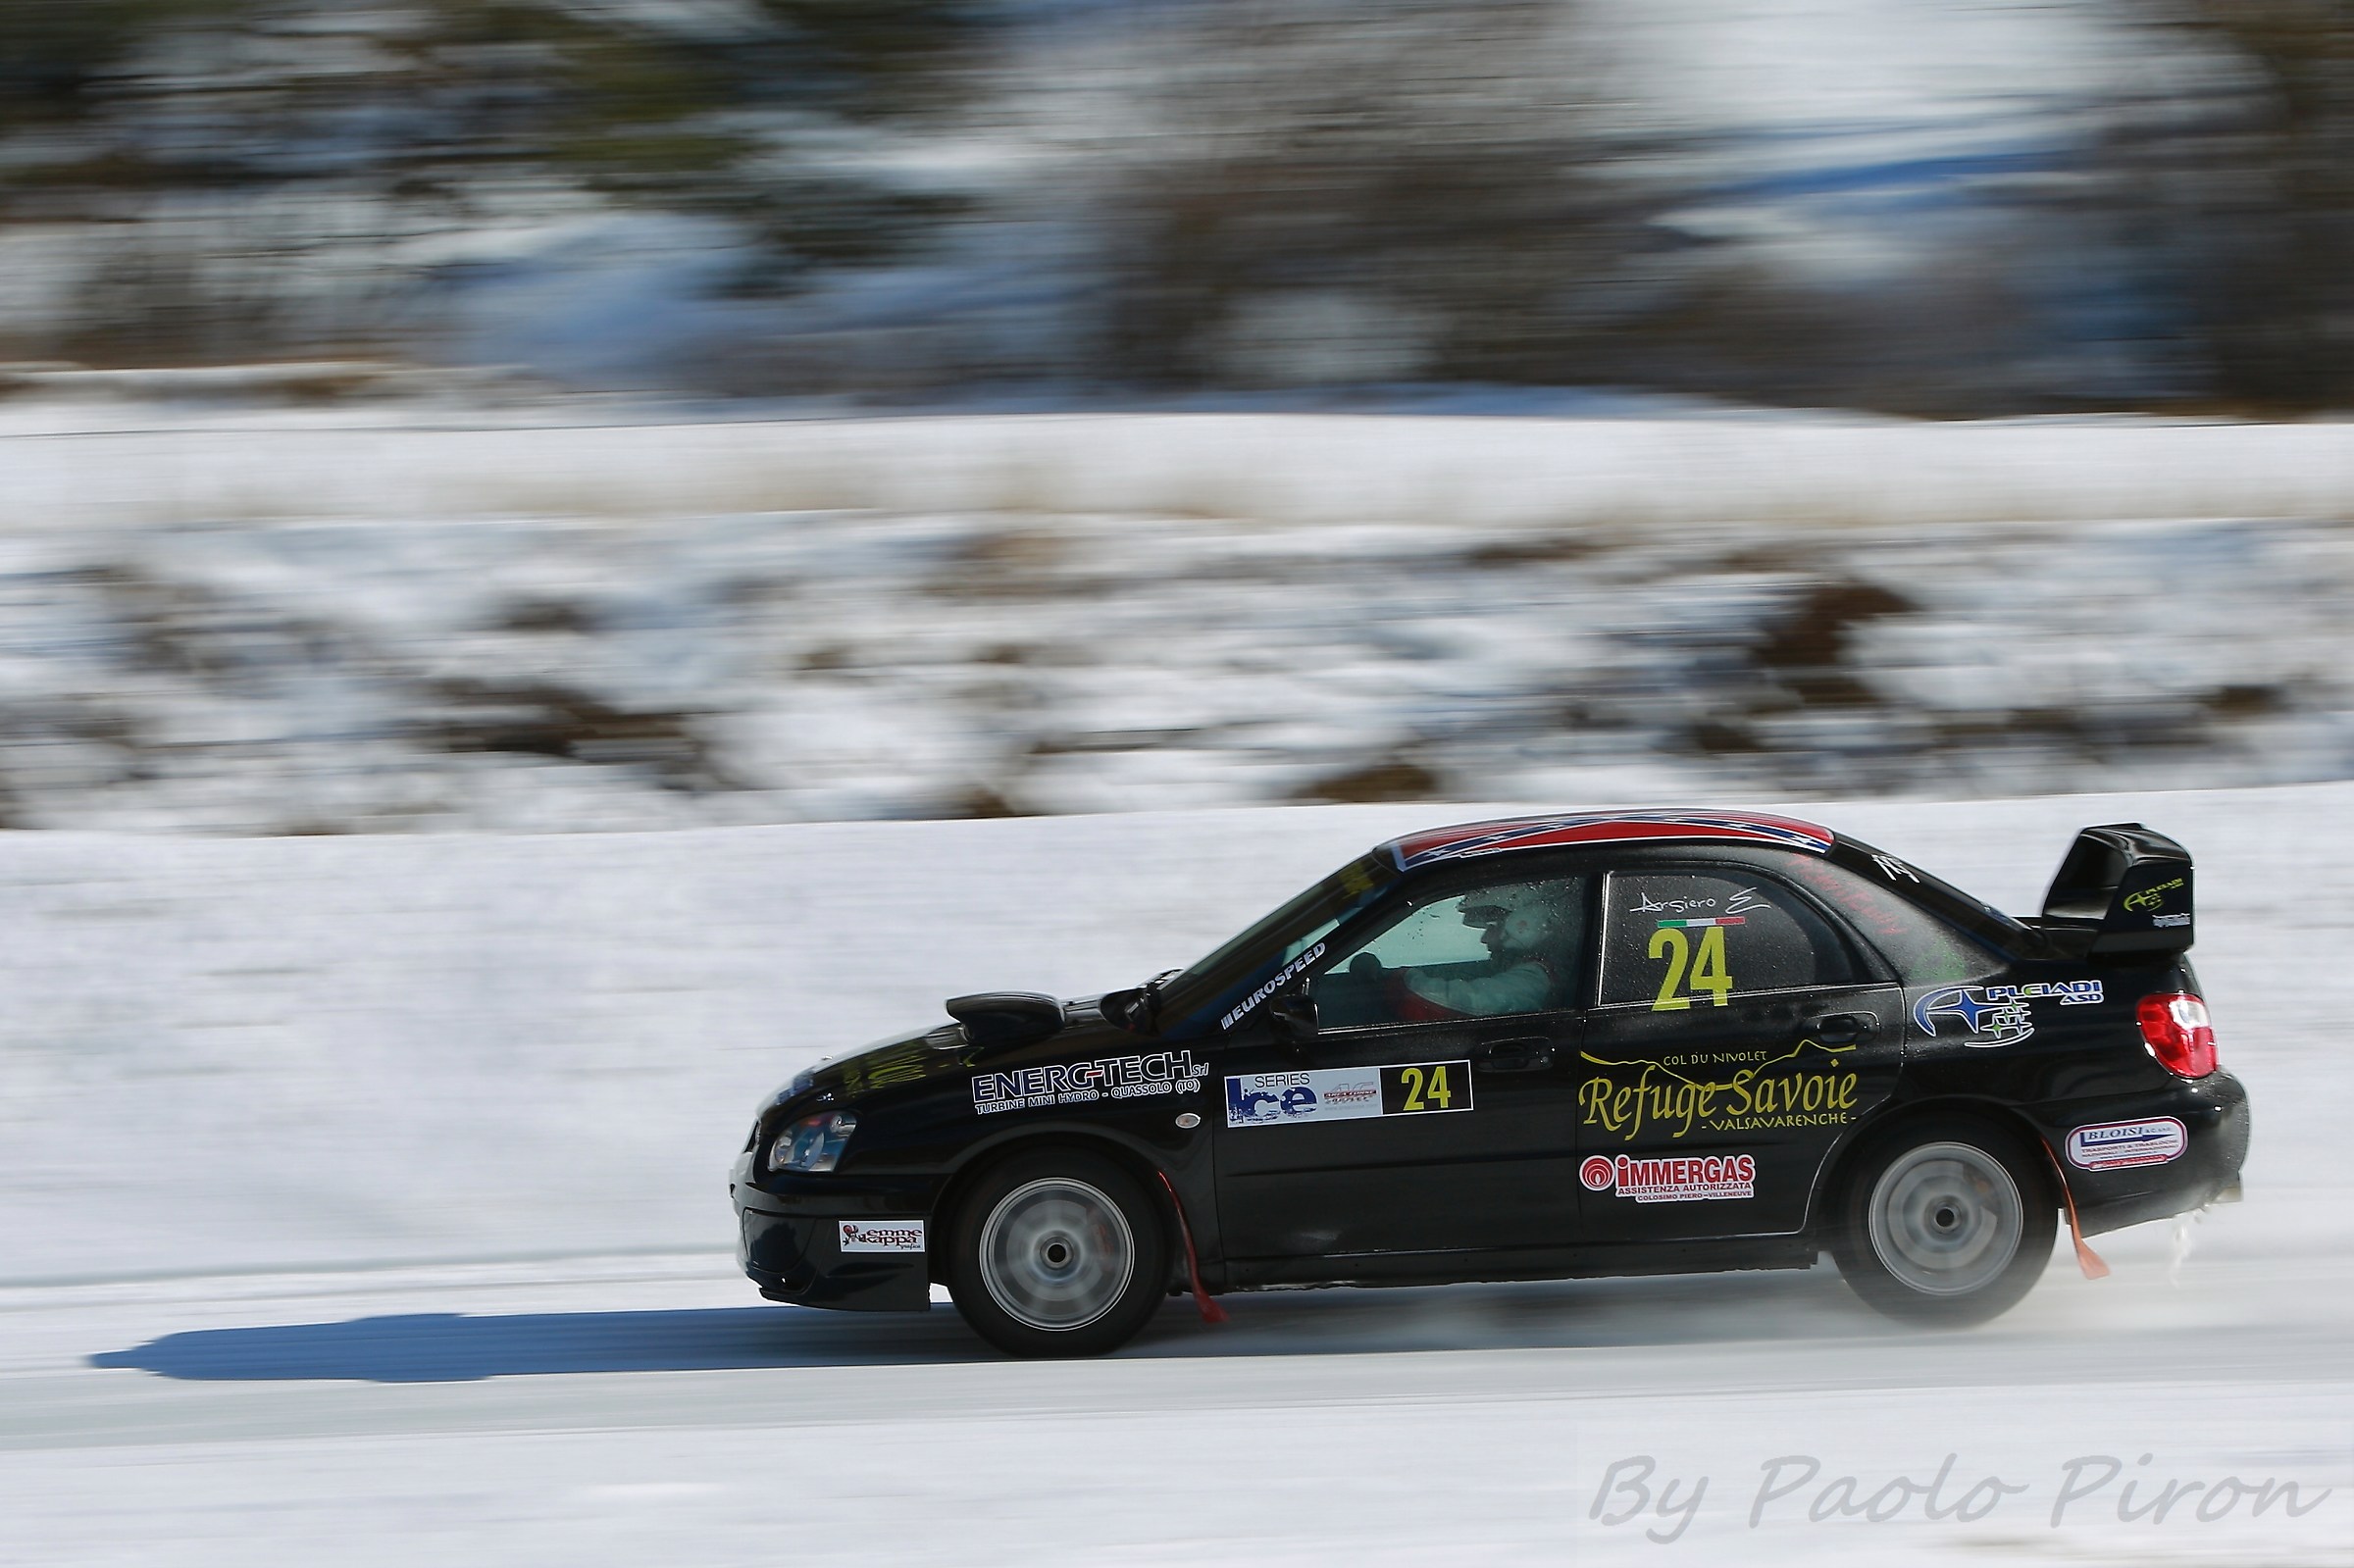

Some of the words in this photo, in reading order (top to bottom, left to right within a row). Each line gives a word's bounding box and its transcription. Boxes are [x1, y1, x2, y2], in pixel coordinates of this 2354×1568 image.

[1629, 892, 1716, 913] Arsiero
[1648, 926, 1733, 1012] 24
[1232, 941, 1326, 1022] EUROSPEED
[1986, 980, 2103, 1000] PLEIADI
[2060, 993, 2105, 1005] ASD
[1663, 1054, 1685, 1066] COL
[1691, 1051, 1708, 1064] DU
[1714, 1050, 1767, 1063] NIVOLET
[972, 1050, 1191, 1103] ENERG-TECH
[1191, 1062, 1209, 1077] Srl
[1254, 1073, 1310, 1088] SERIES
[975, 1097, 1025, 1115] TURBINE
[1028, 1091, 1055, 1108] MINI
[1058, 1088, 1100, 1104] HYDRO
[1110, 1081, 1173, 1099] QUASSOLO
[1174, 1078, 1202, 1094] (TO)
[1401, 1066, 1452, 1111] 24
[1578, 1064, 1717, 1141] Refuge
[1726, 1058, 1858, 1116] Savoie
[2088, 1127, 2143, 1140] BLOISI
[1618, 1185, 1680, 1195] ASSISTENZA
[1684, 1182, 1751, 1191] AUTORIZZATA
